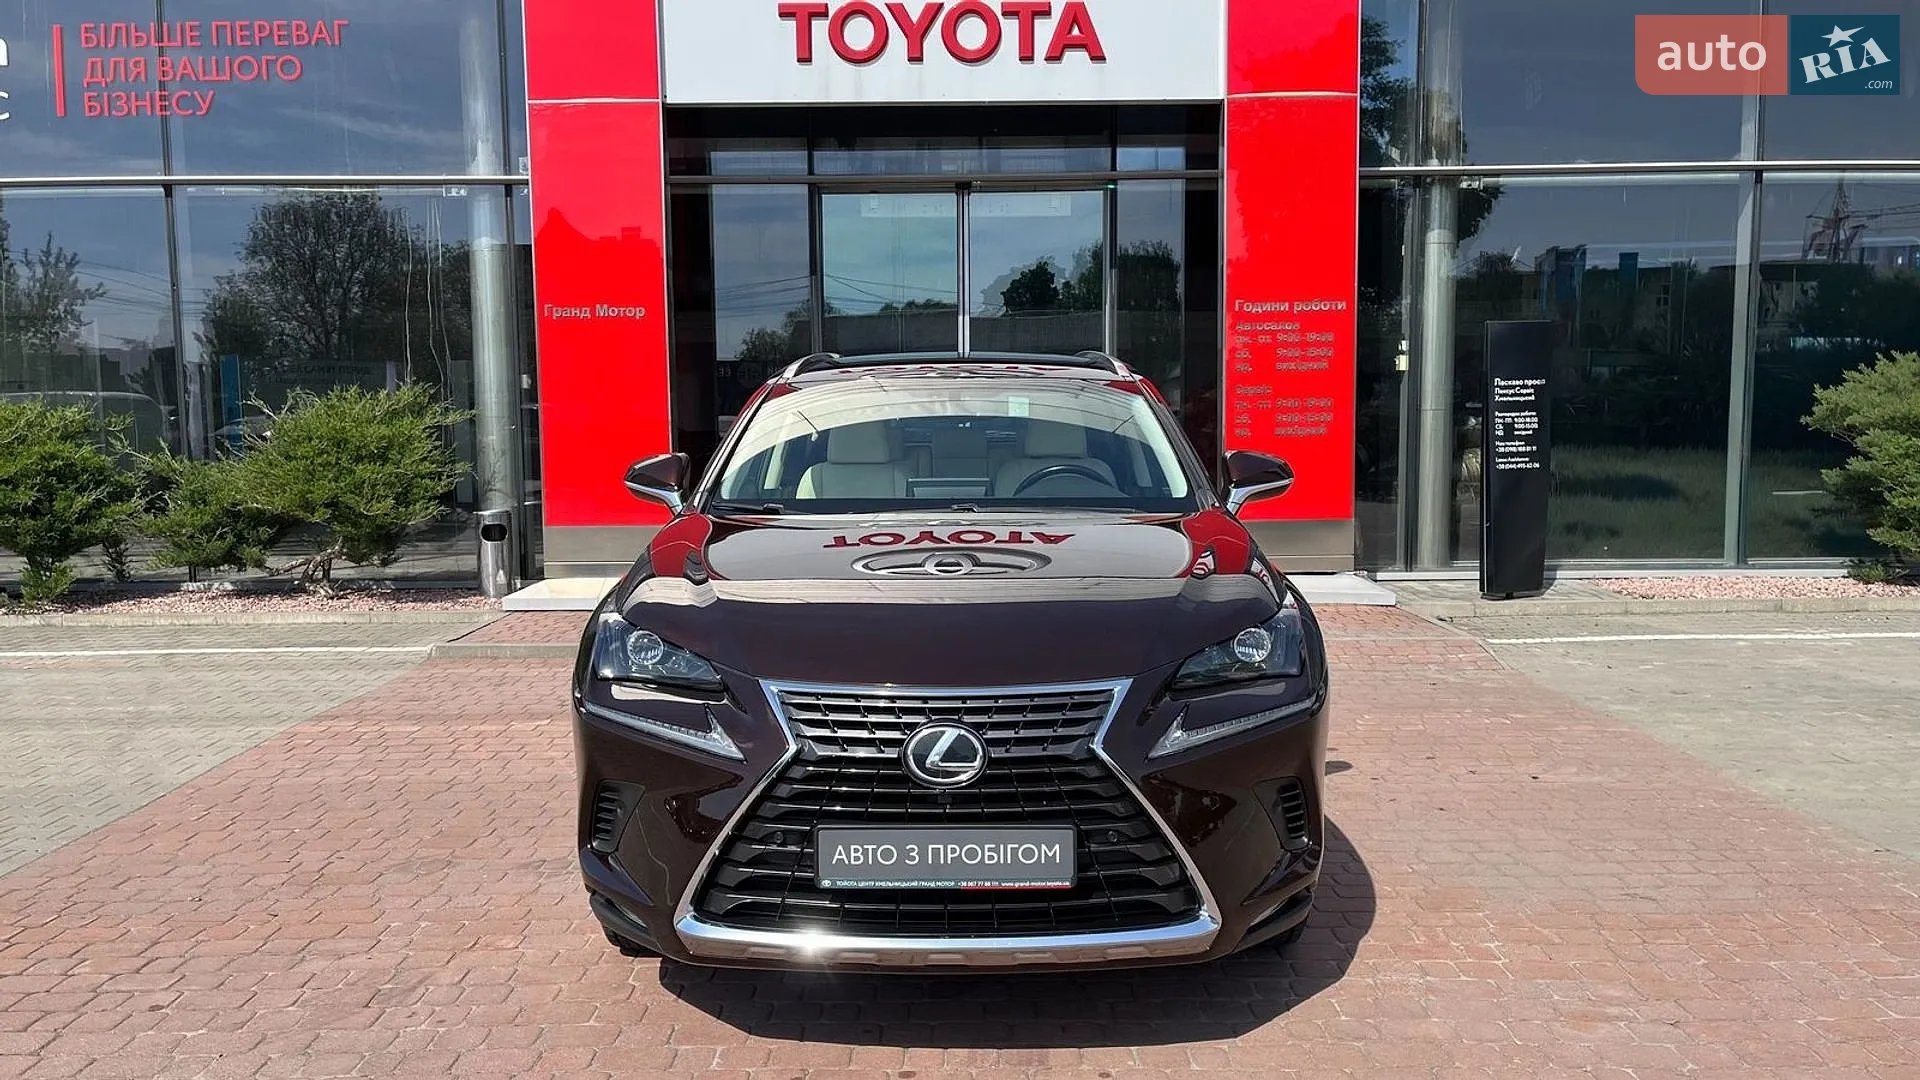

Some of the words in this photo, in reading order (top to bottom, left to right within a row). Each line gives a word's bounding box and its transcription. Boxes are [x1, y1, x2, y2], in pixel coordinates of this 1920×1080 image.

[80, 21, 202, 48] БІЛЬШЕ
[211, 20, 349, 46] ПЕРЕВАГ
[778, 1, 1106, 64] TOYOTA
[83, 56, 147, 86] ДЛЯ
[157, 55, 303, 82] ВАШОГО
[83, 90, 216, 117] БІЗНЕСУ
[544, 304, 591, 319] Гранд
[595, 304, 646, 319] Мотор
[1235, 299, 1289, 313] Години
[1293, 298, 1347, 313] роботи
[832, 844, 898, 865] АВТО
[904, 844, 920, 864] З
[927, 843, 1060, 865] ПРОБІГОМ
